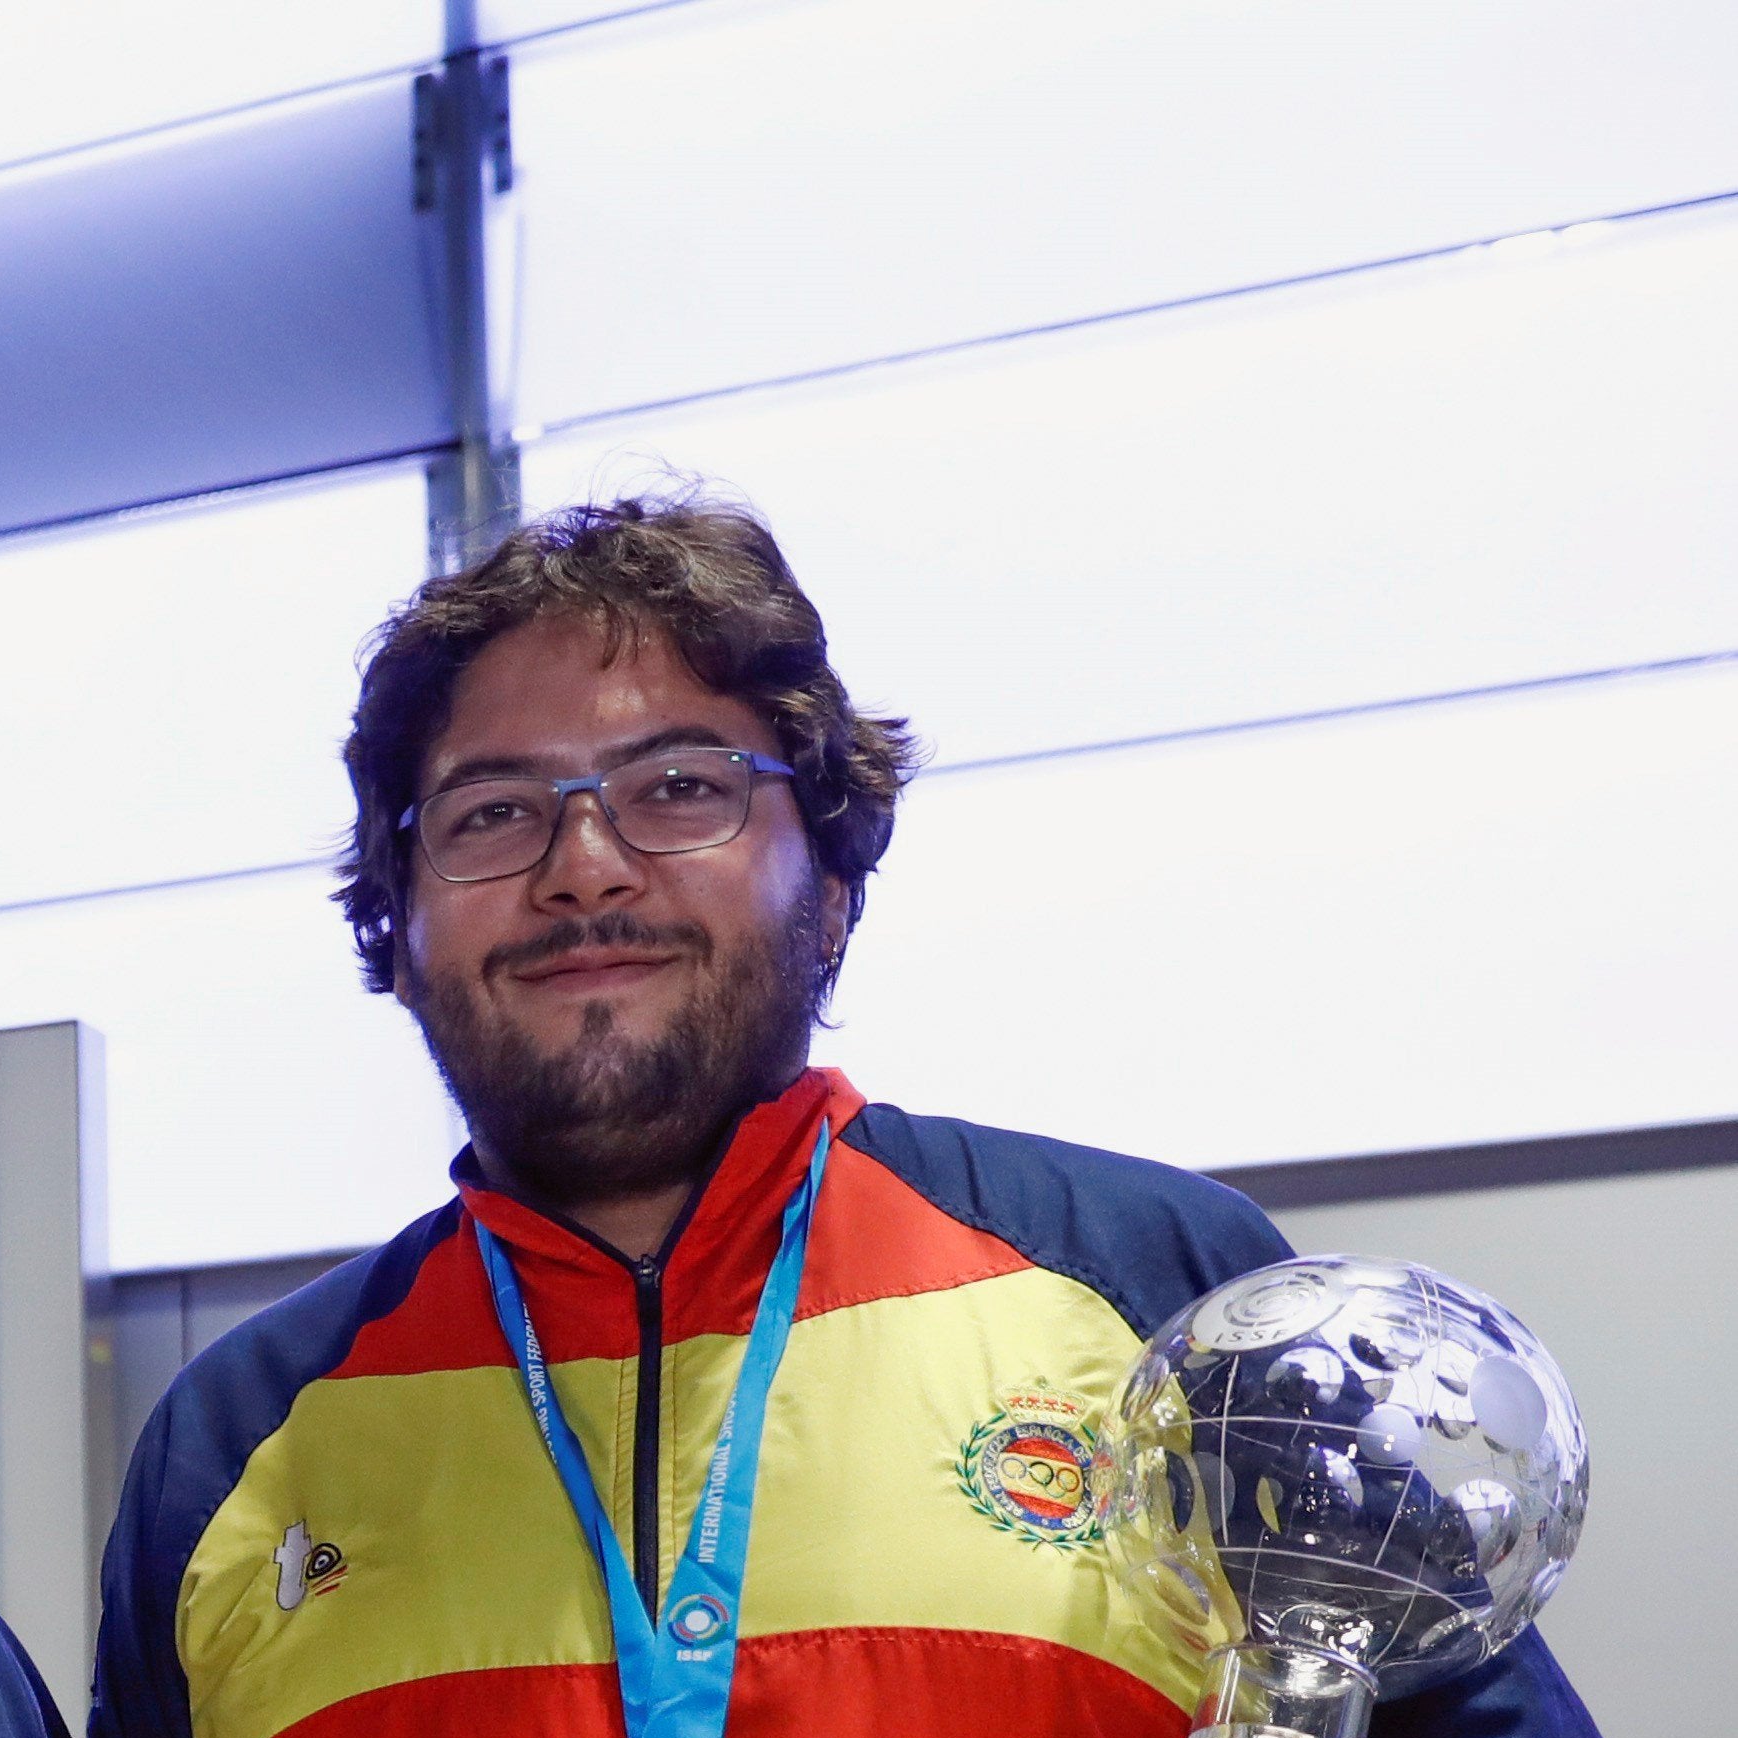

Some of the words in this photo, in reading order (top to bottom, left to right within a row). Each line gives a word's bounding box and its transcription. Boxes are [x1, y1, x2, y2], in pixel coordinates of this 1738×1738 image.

[1215, 1329, 1288, 1344] ISSF
[528, 1364, 547, 1405] SPORT
[698, 1441, 730, 1563] INTERNATIONAL
[676, 1650, 713, 1662] ISSF
